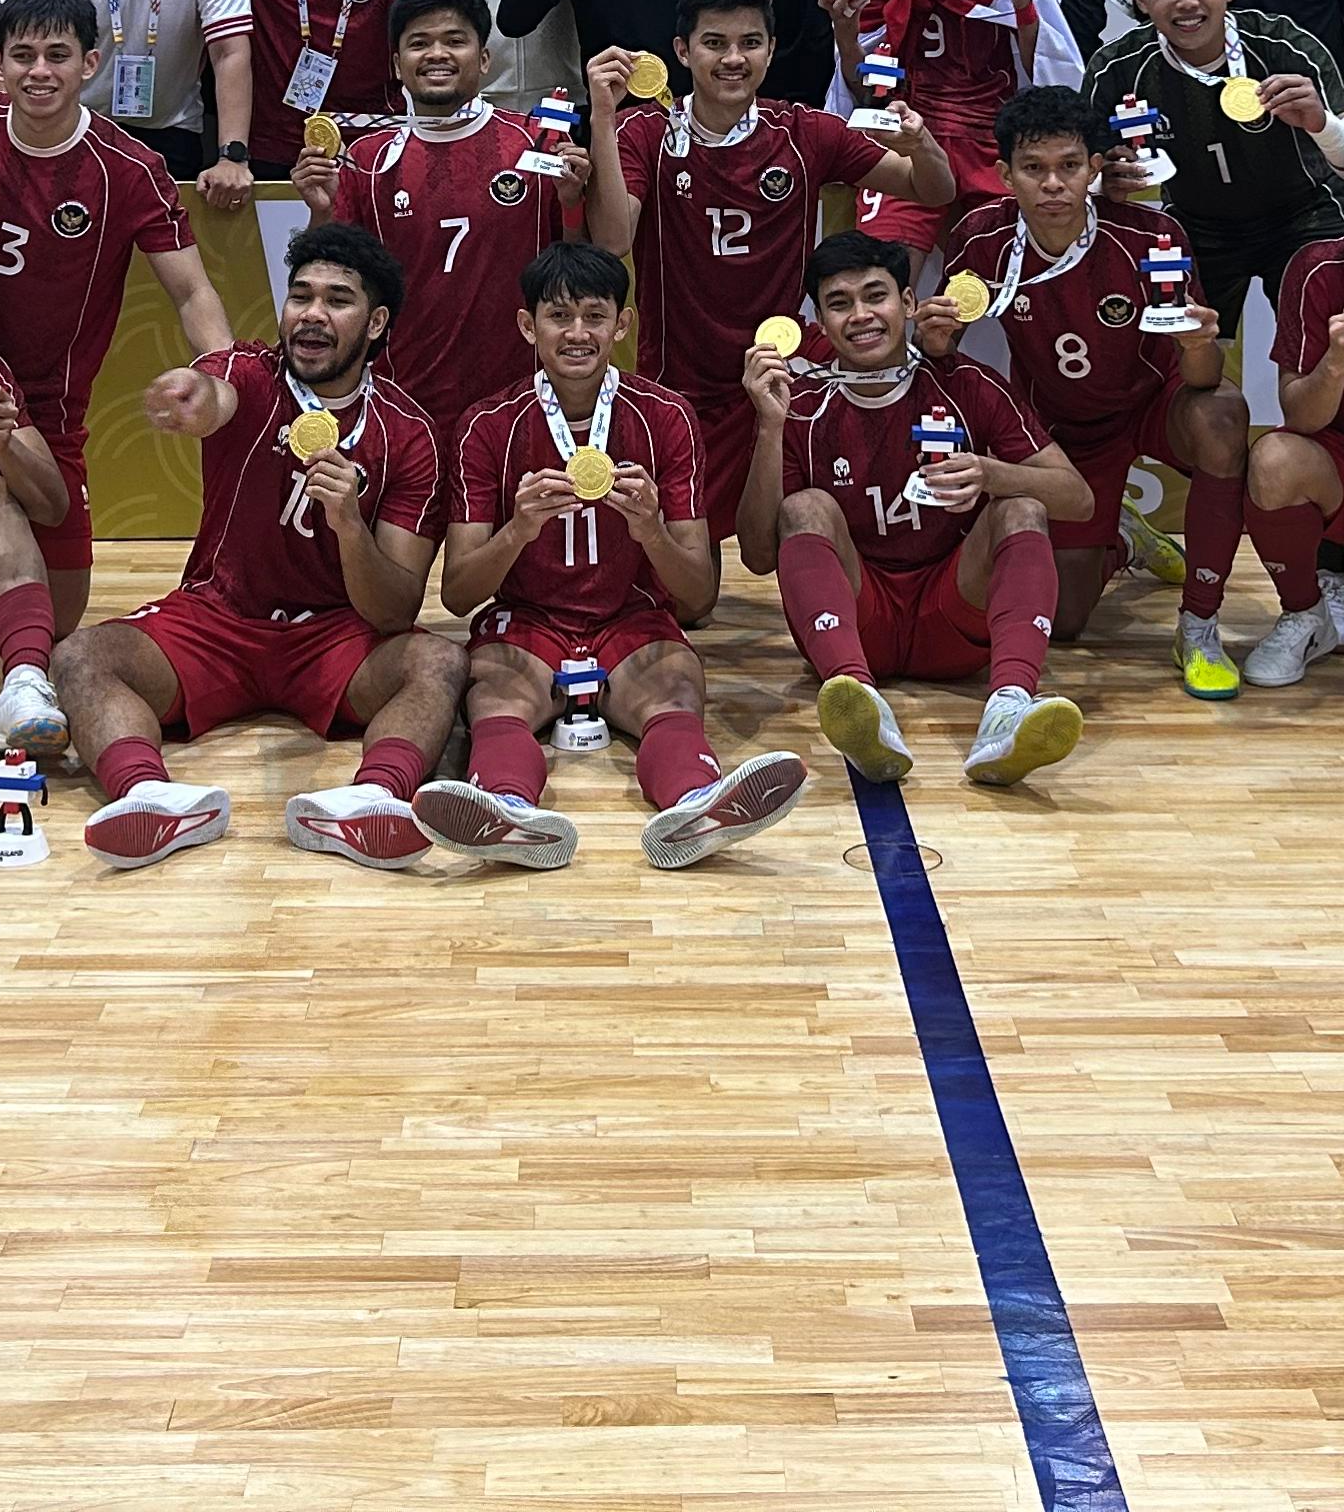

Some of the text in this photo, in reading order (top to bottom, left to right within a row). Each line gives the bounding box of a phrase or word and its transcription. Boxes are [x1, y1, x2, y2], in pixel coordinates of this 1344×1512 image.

[922, 13, 945, 58] 9
[1207, 143, 1232, 183] 1
[440, 217, 470, 272] 7
[706, 208, 751, 255] 12
[1055, 333, 1091, 379] 8
[866, 486, 922, 535] 14
[558, 508, 598, 567] 11
